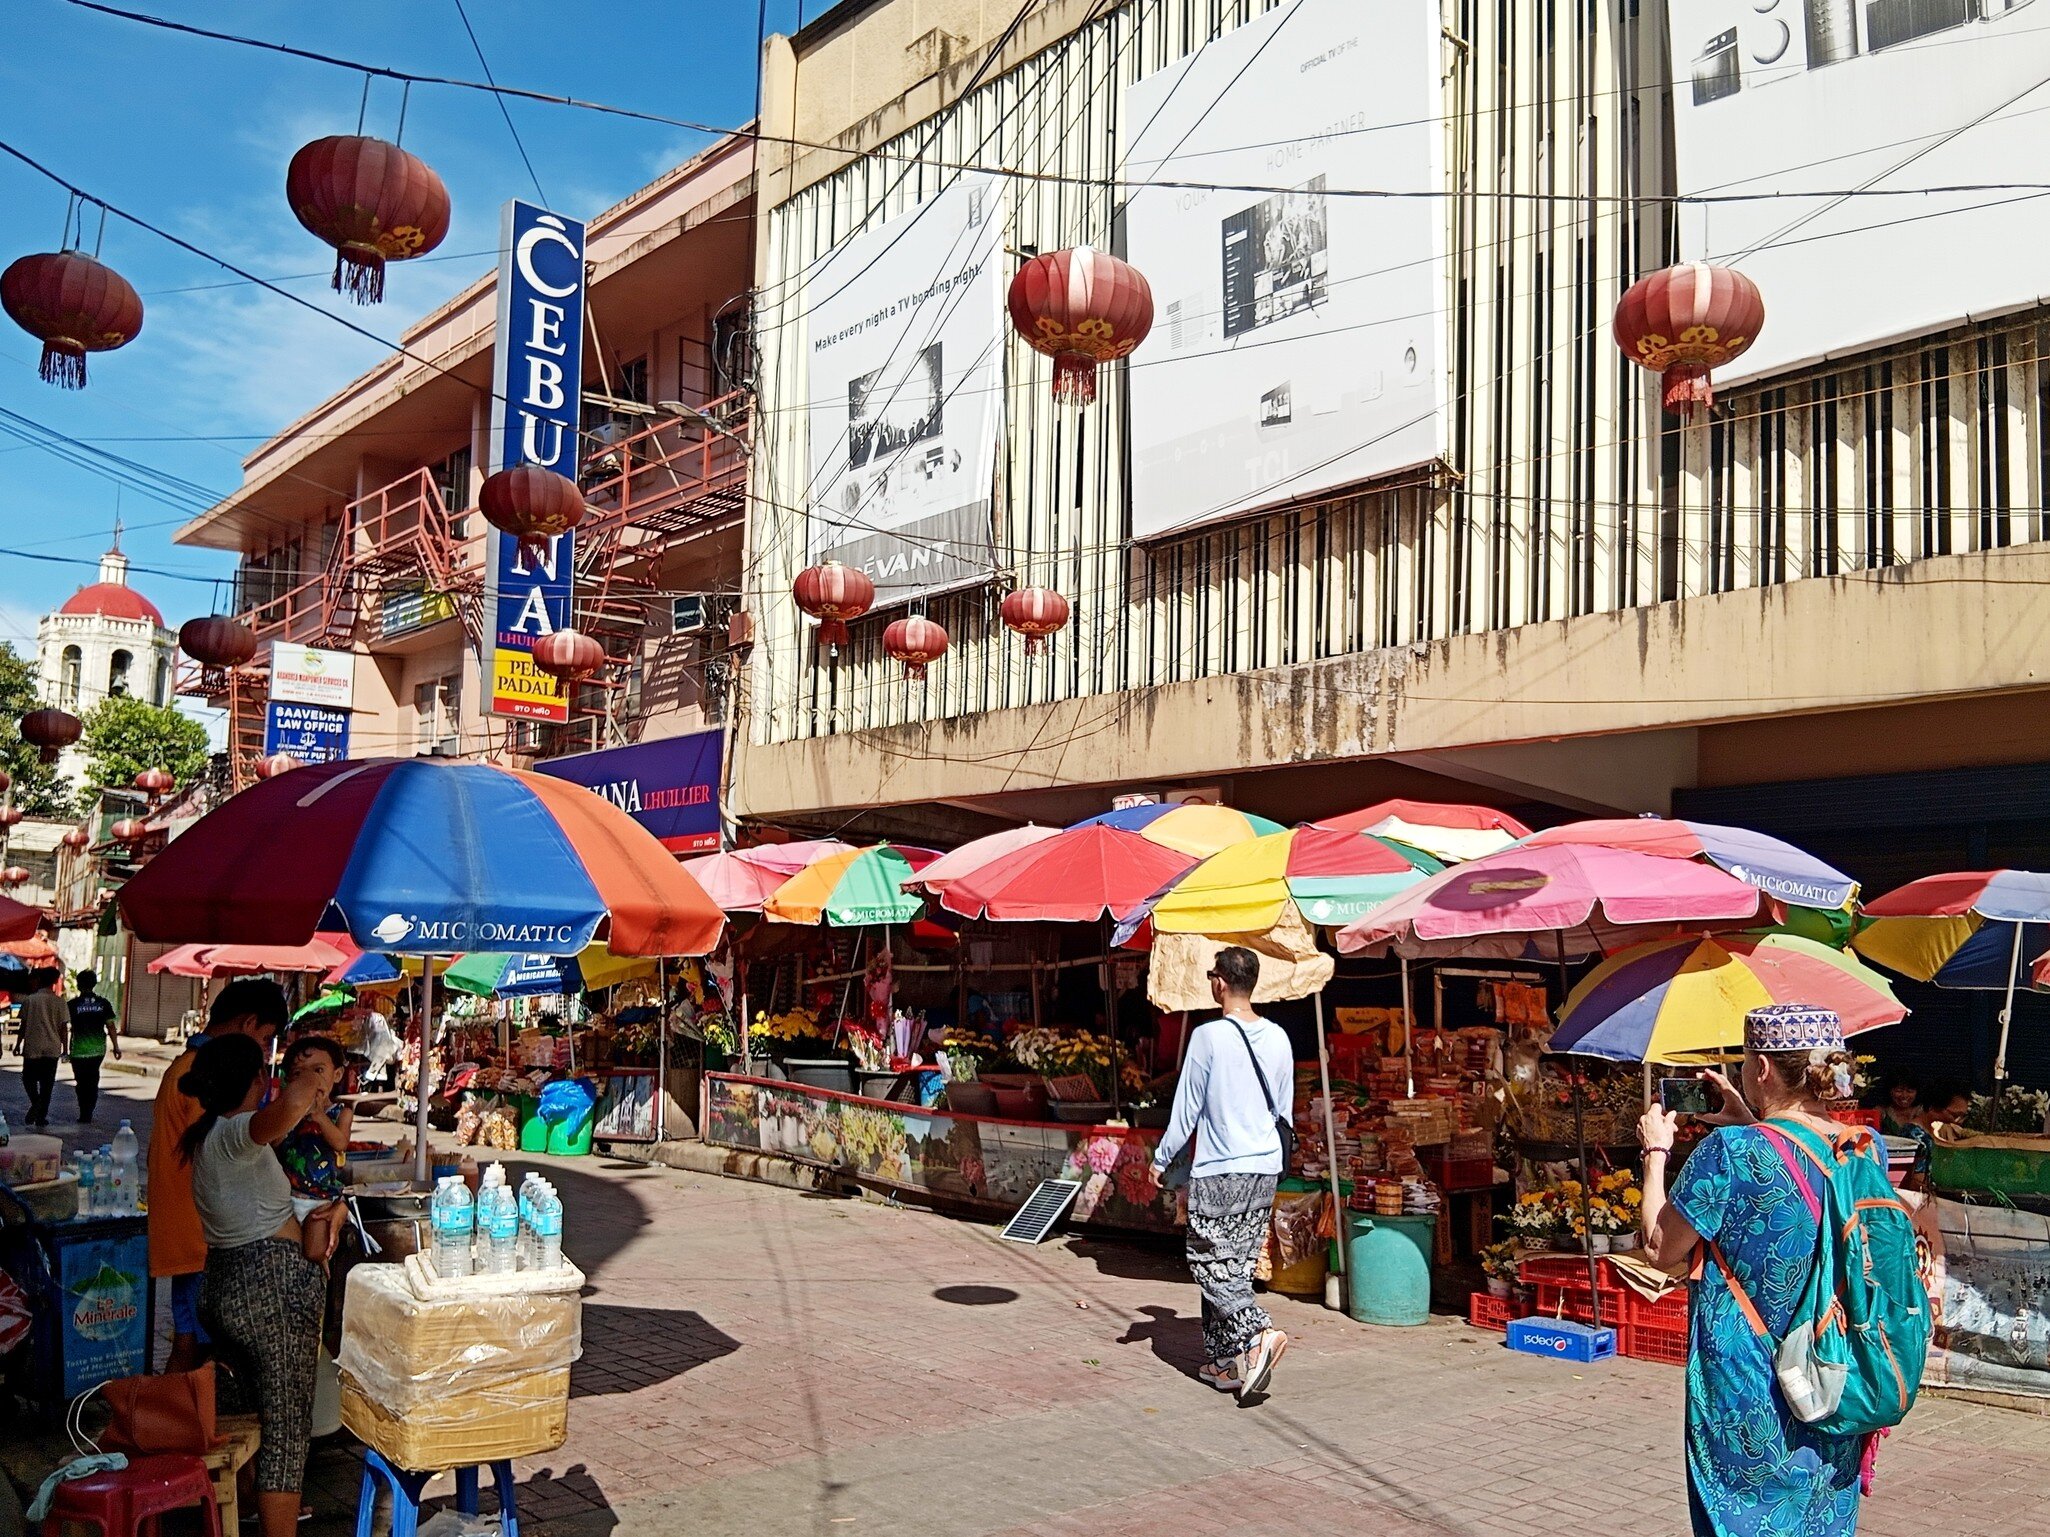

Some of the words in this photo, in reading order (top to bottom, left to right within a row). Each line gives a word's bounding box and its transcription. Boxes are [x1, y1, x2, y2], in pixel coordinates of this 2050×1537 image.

[1266, 145, 1302, 173] HOME
[1310, 111, 1366, 153] PARTNER
[815, 335, 837, 352] Make
[839, 321, 864, 341] every
[865, 309, 888, 329] night
[890, 305, 896, 316] a
[898, 297, 911, 313] TV
[912, 278, 951, 305] bonding
[510, 216, 580, 637] CEBUNA
[1245, 448, 1290, 488] TCL
[855, 539, 952, 581] ÉVANT
[510, 660, 553, 680] PER
[497, 676, 562, 698] PADAL
[276, 706, 345, 723] SAAVEDRA
[514, 704, 531, 713] STO
[276, 718, 302, 730] LAW
[303, 720, 343, 733] OFFICE
[643, 784, 711, 811] LHUILLIER
[1750, 872, 1838, 904] MICROMATIC
[418, 920, 572, 944] MICROMATIC
[73, 1304, 137, 1327] Minerale
[1523, 1333, 1554, 1348] pepsi
